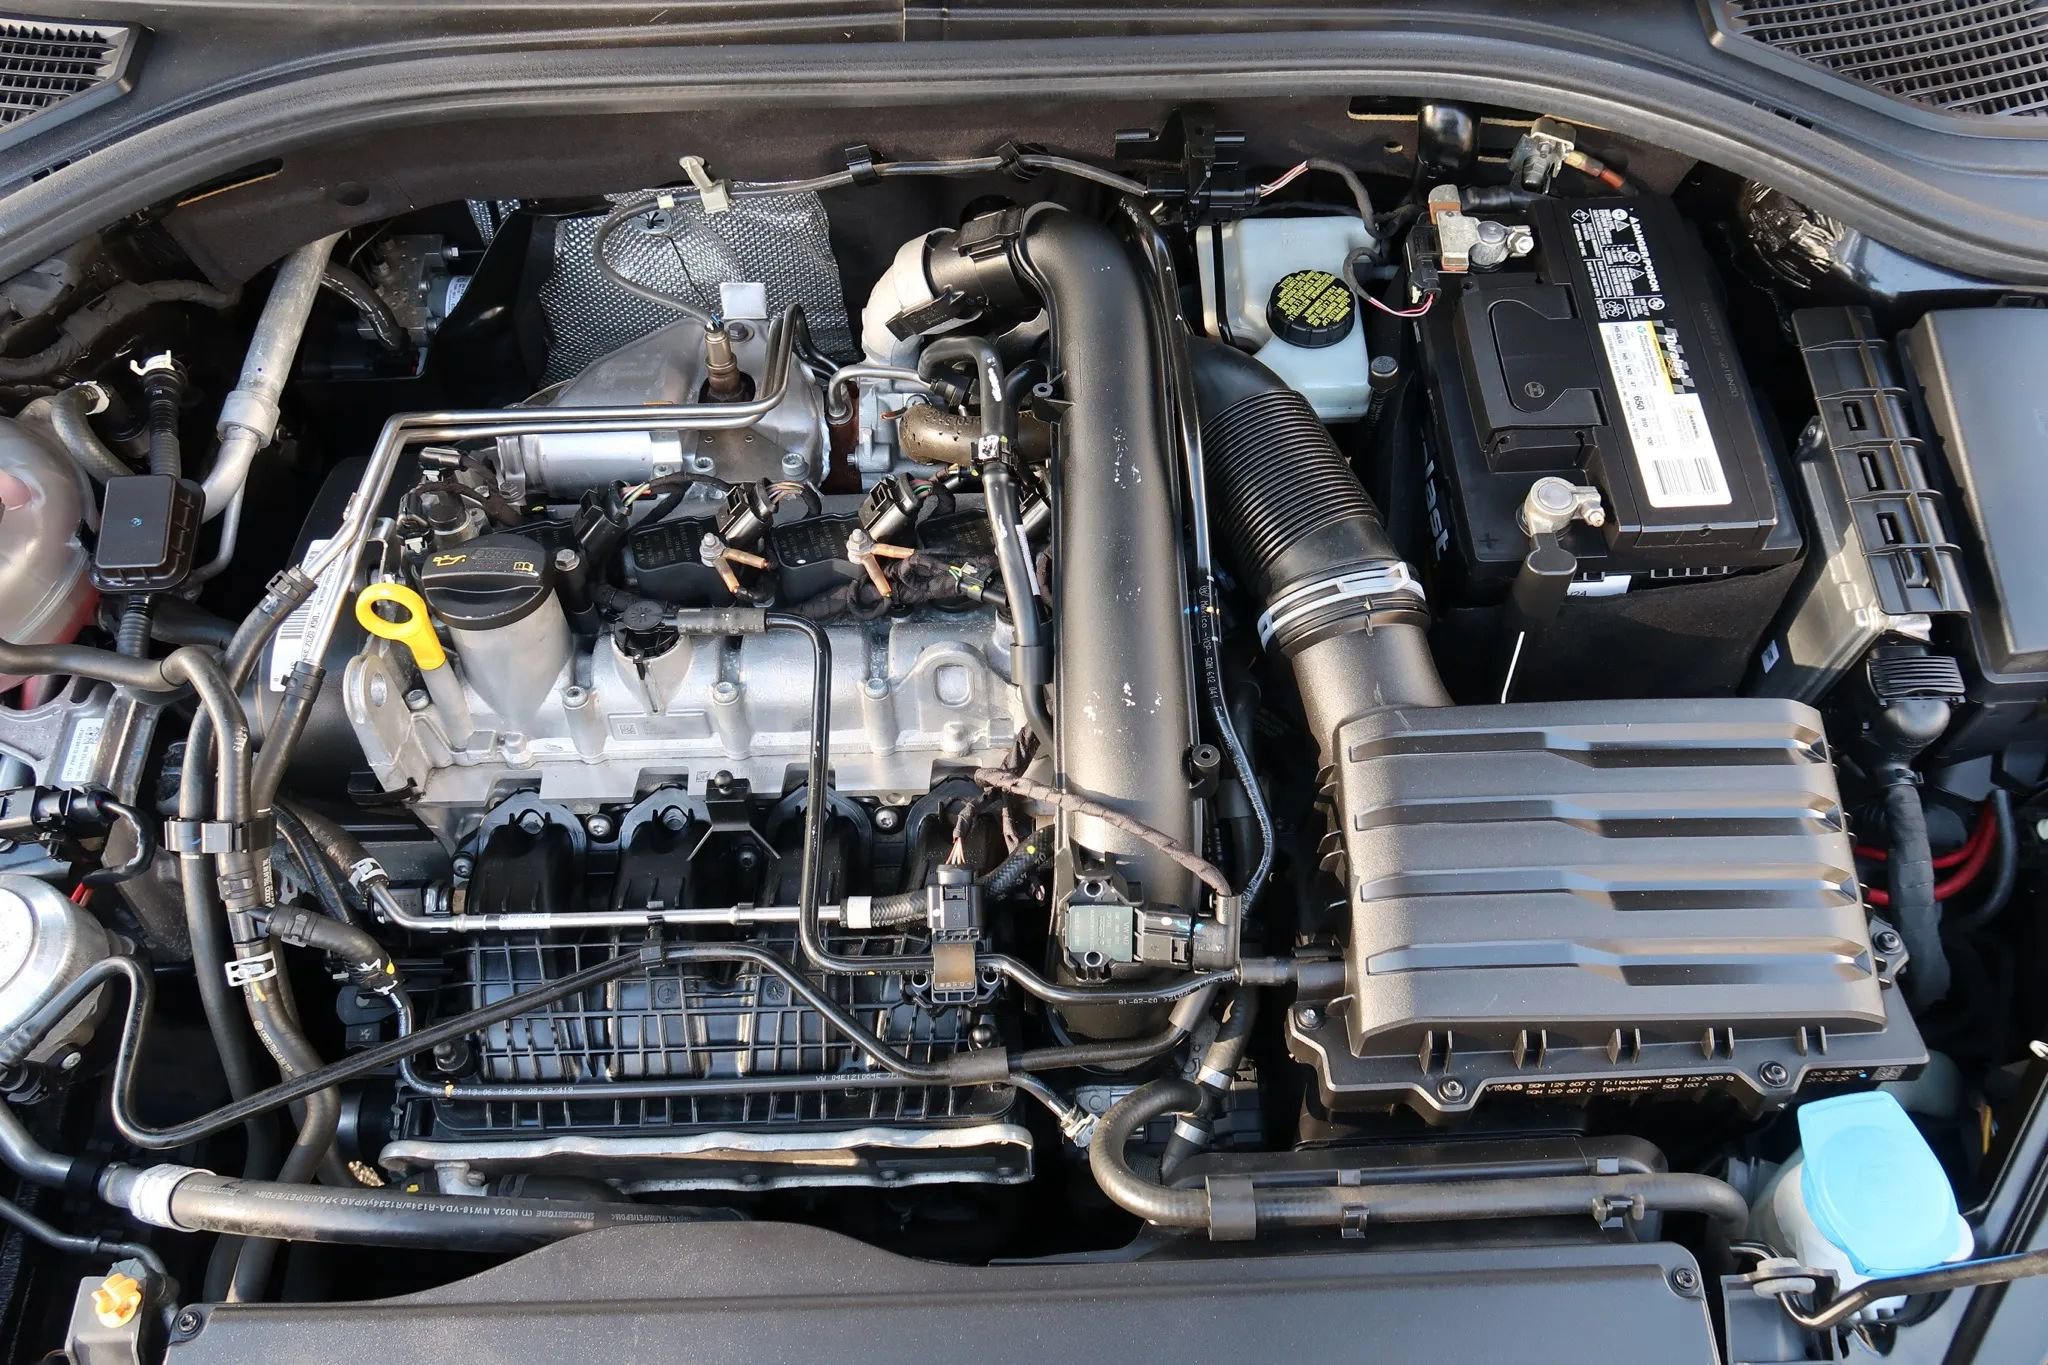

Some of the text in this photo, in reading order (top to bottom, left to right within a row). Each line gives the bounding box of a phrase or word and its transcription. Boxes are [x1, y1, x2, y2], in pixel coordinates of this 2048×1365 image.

[1664, 333, 1689, 379] Duralast
[1632, 394, 1645, 411] 650
[492, 1206, 518, 1216] ND2A
